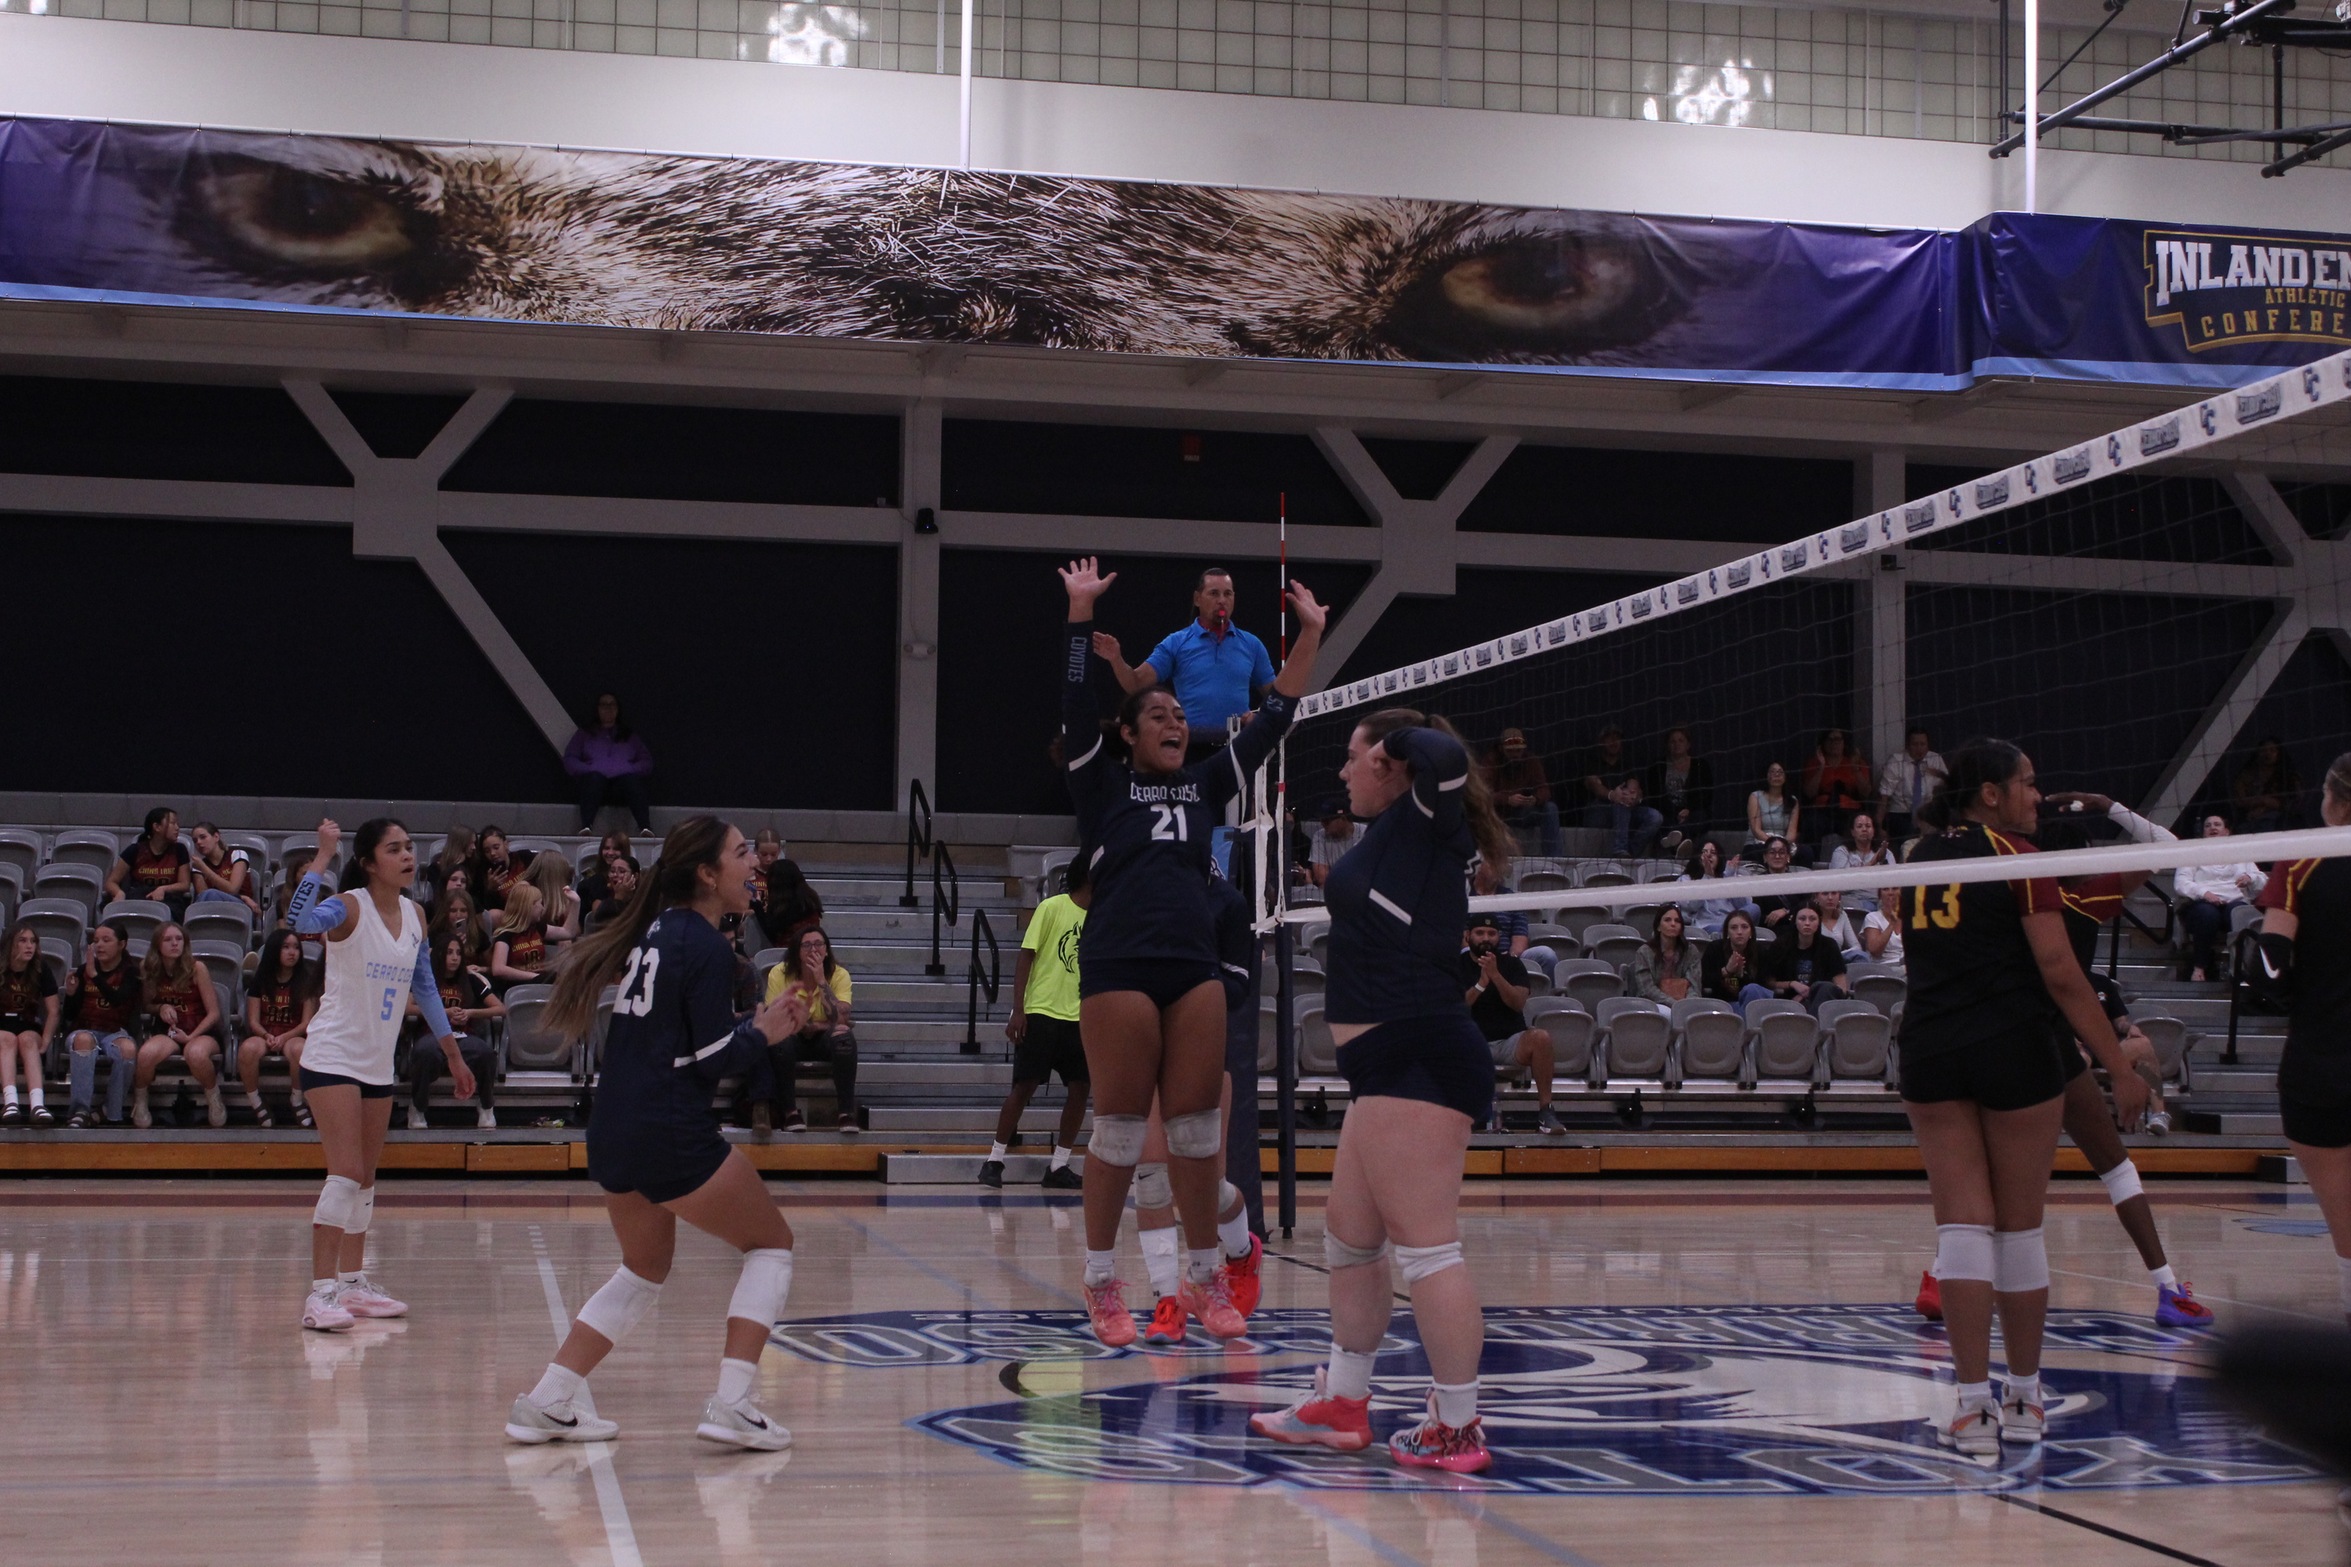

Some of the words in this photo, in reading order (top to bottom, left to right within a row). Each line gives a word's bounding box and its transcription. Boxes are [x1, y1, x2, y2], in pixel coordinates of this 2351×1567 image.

[2155, 240, 2309, 307] INLAND
[2265, 287, 2347, 309] ATHLETIC
[2200, 308, 2345, 338] CONFERE
[1067, 636, 1088, 683] COYOTES
[1130, 782, 1168, 803] CERRO
[1150, 803, 1188, 842] 21
[1911, 882, 1962, 930] 13
[366, 962, 398, 981] CERRO
[612, 946, 660, 1018] 23
[381, 988, 397, 1020] 5
[933, 1416, 2324, 1493] YOTES
